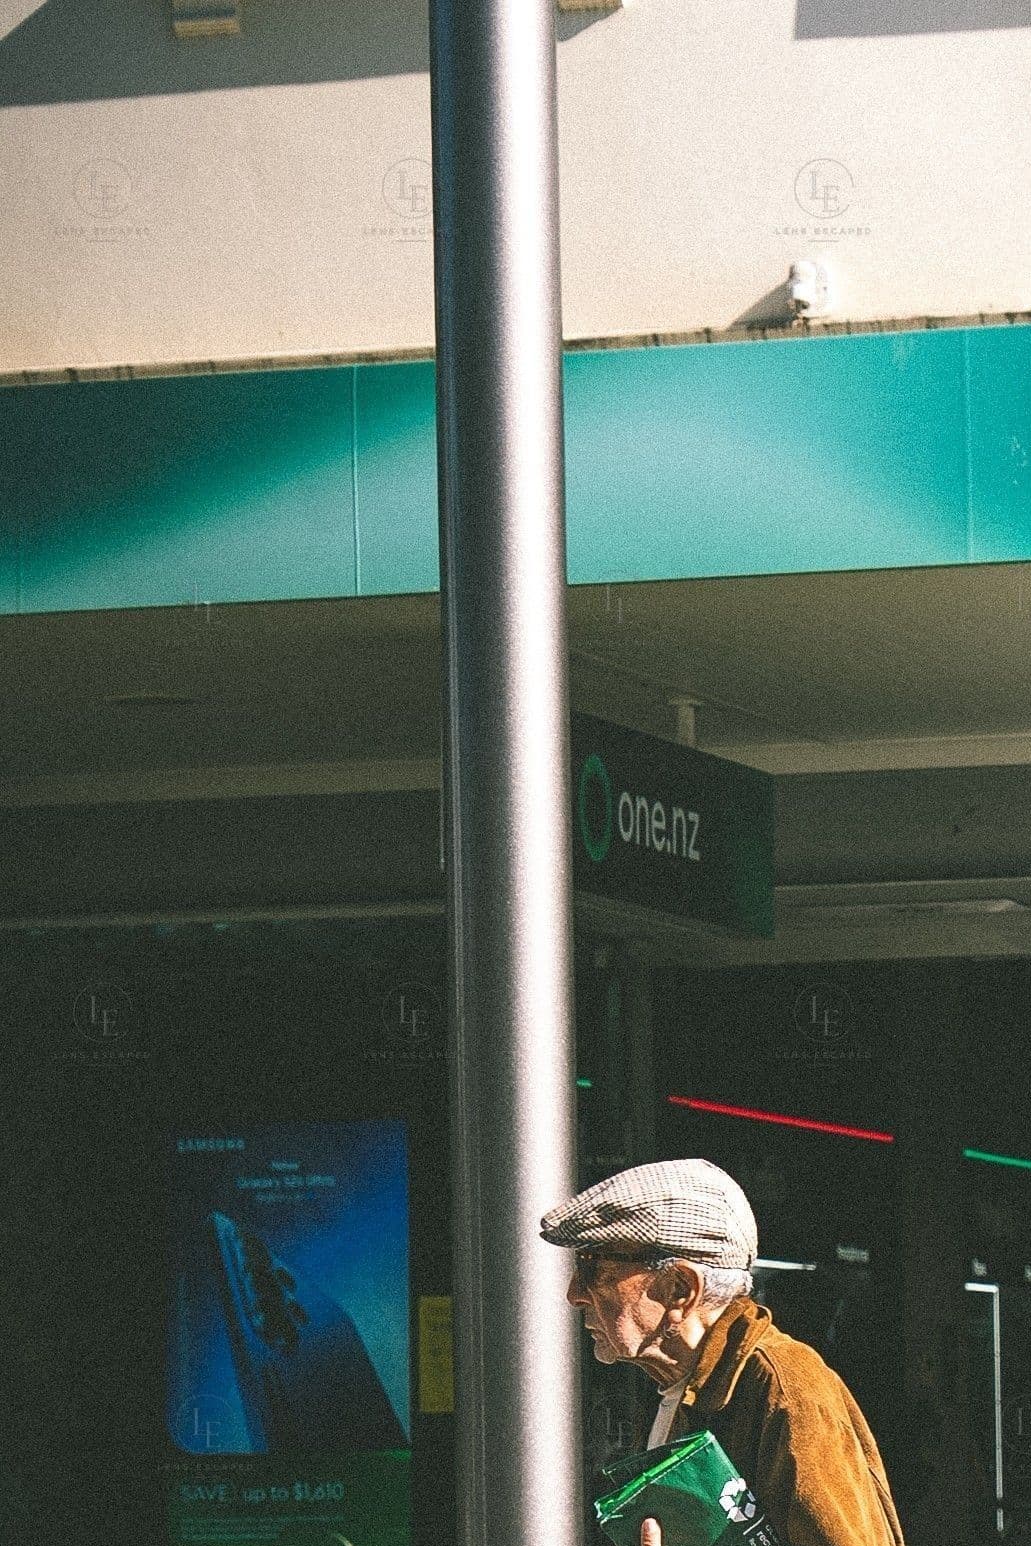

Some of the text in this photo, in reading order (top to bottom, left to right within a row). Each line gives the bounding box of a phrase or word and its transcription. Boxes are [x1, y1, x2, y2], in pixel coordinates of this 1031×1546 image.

[618, 791, 700, 861] one.nz
[180, 1482, 227, 1502] SAVE
[243, 1487, 267, 1504] up
[270, 1484, 289, 1501] to
